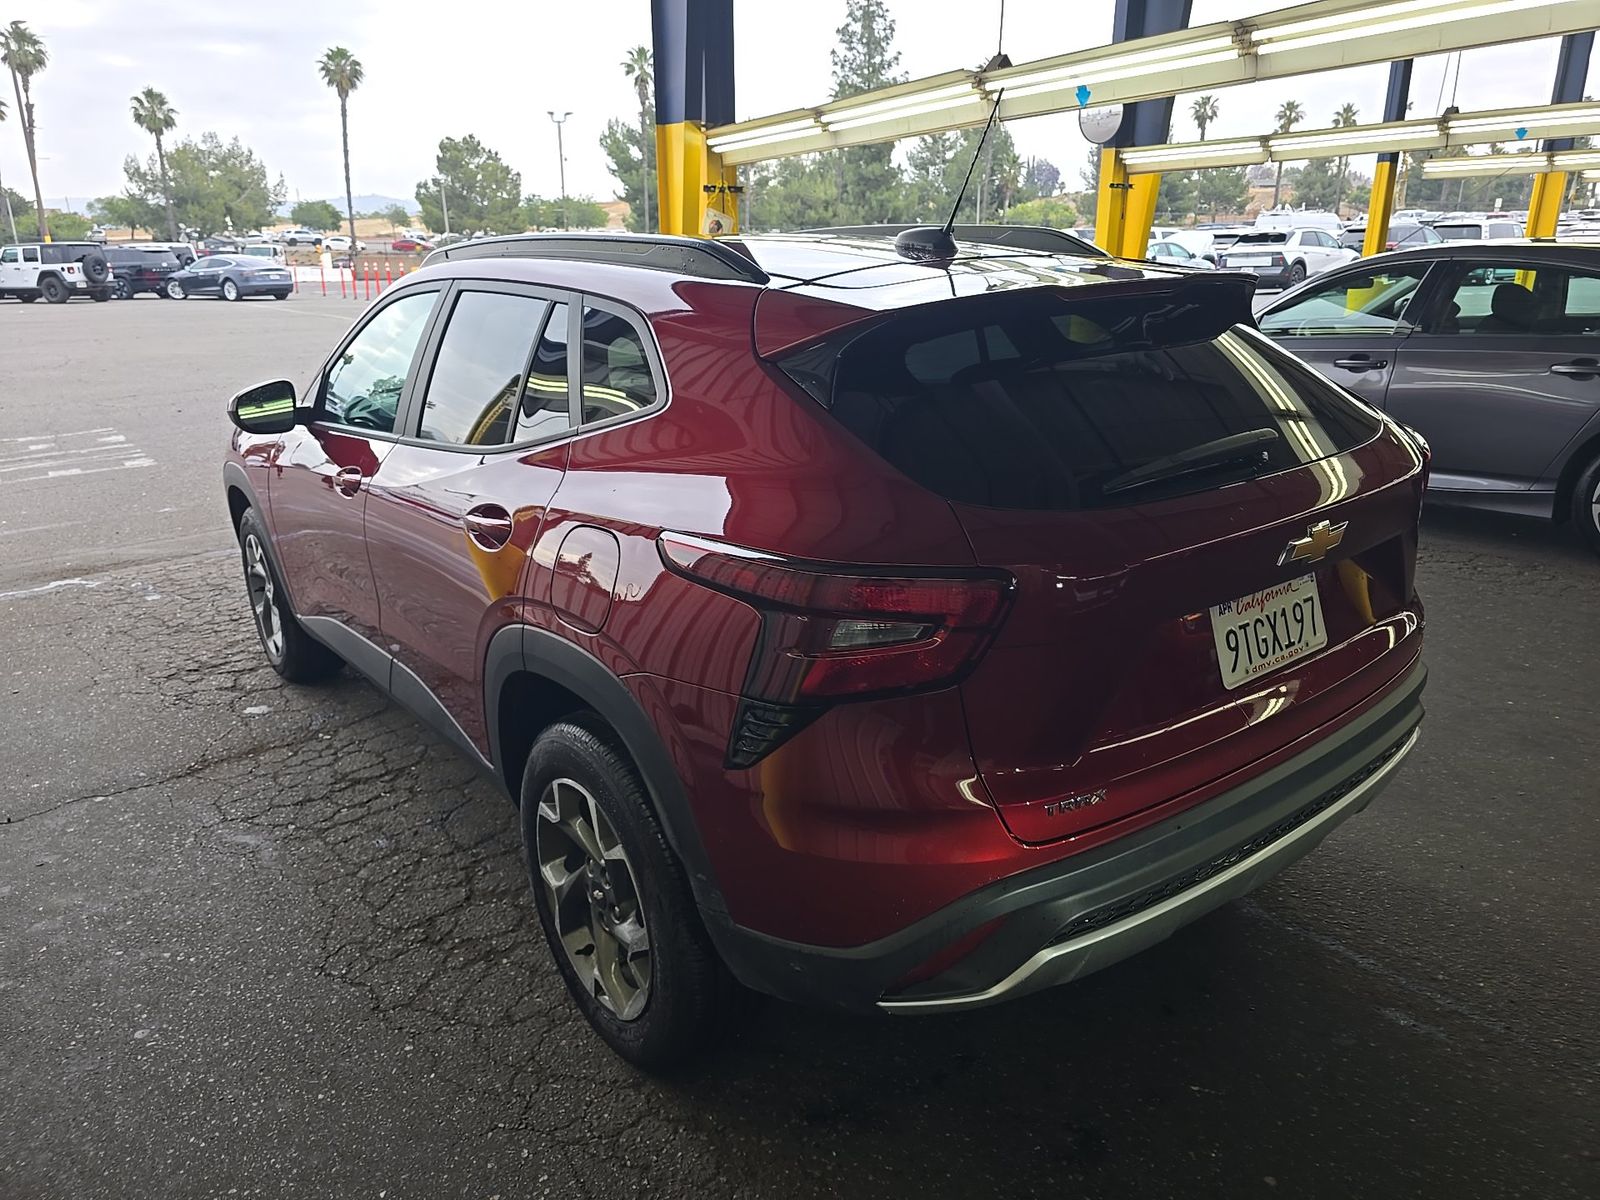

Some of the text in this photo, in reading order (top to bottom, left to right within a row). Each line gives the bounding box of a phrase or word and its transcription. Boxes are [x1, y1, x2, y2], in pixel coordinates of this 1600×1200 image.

[1218, 602, 1233, 617] APR
[1234, 582, 1300, 615] California
[1225, 595, 1317, 674] 9TGX197
[1252, 645, 1304, 674] dmv.ca.gov
[1044, 788, 1107, 816] TRAX
